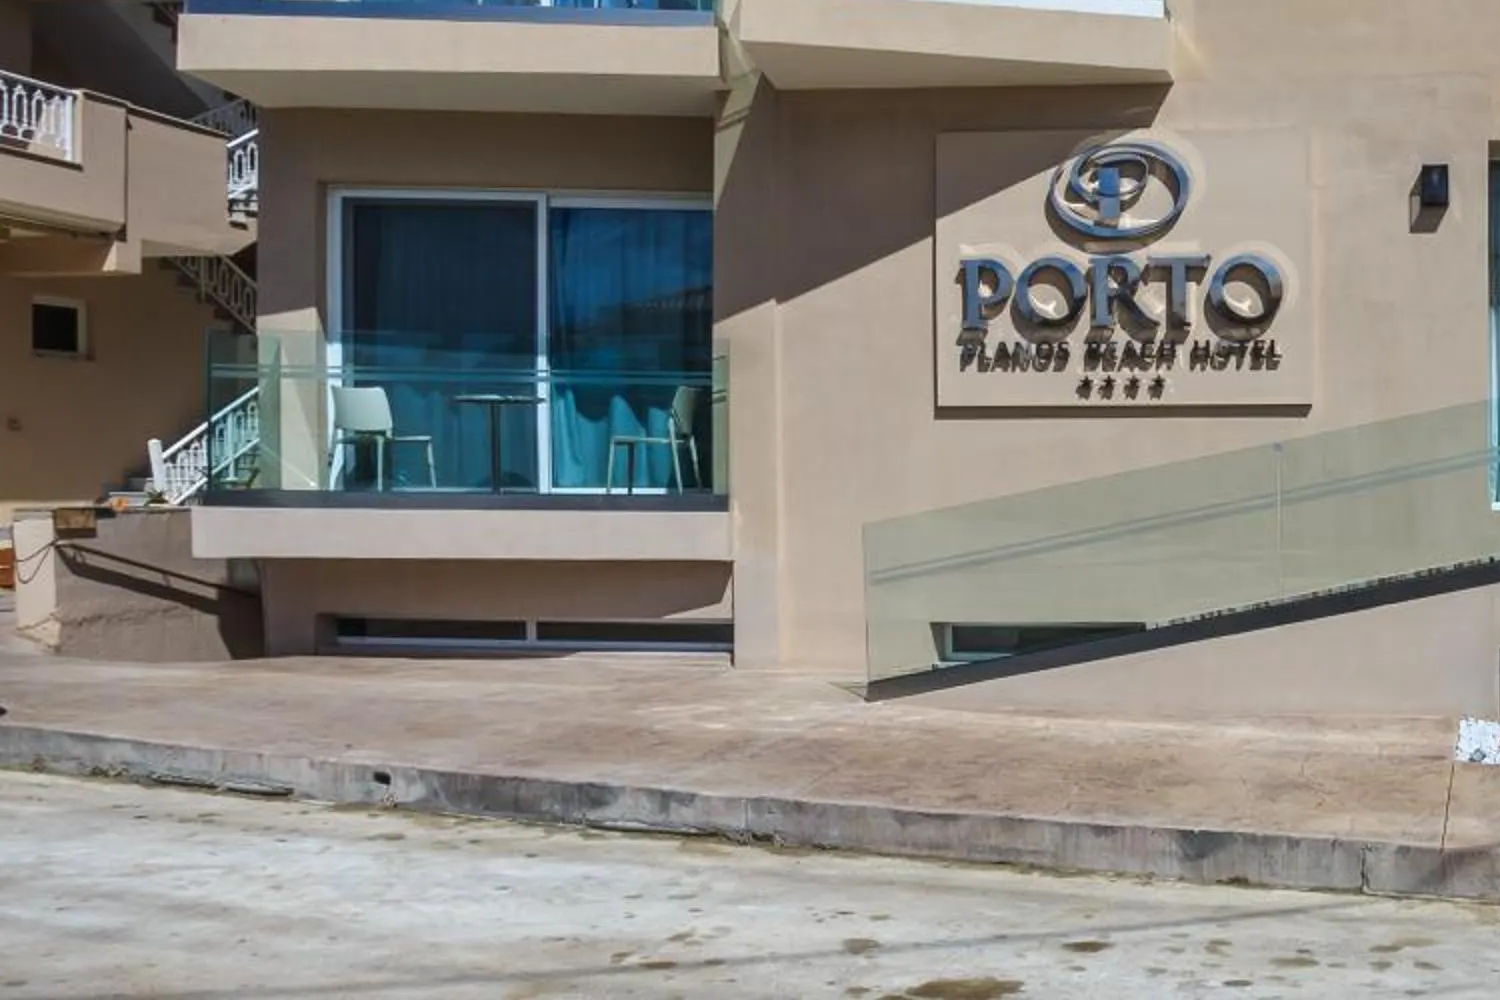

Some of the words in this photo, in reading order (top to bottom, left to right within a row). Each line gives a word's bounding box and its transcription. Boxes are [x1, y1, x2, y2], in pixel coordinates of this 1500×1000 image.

[959, 253, 1284, 333] PORTO
[960, 340, 1071, 370] PLANOS
[1083, 340, 1177, 370] BEACH
[1189, 340, 1283, 369] HOTEL
